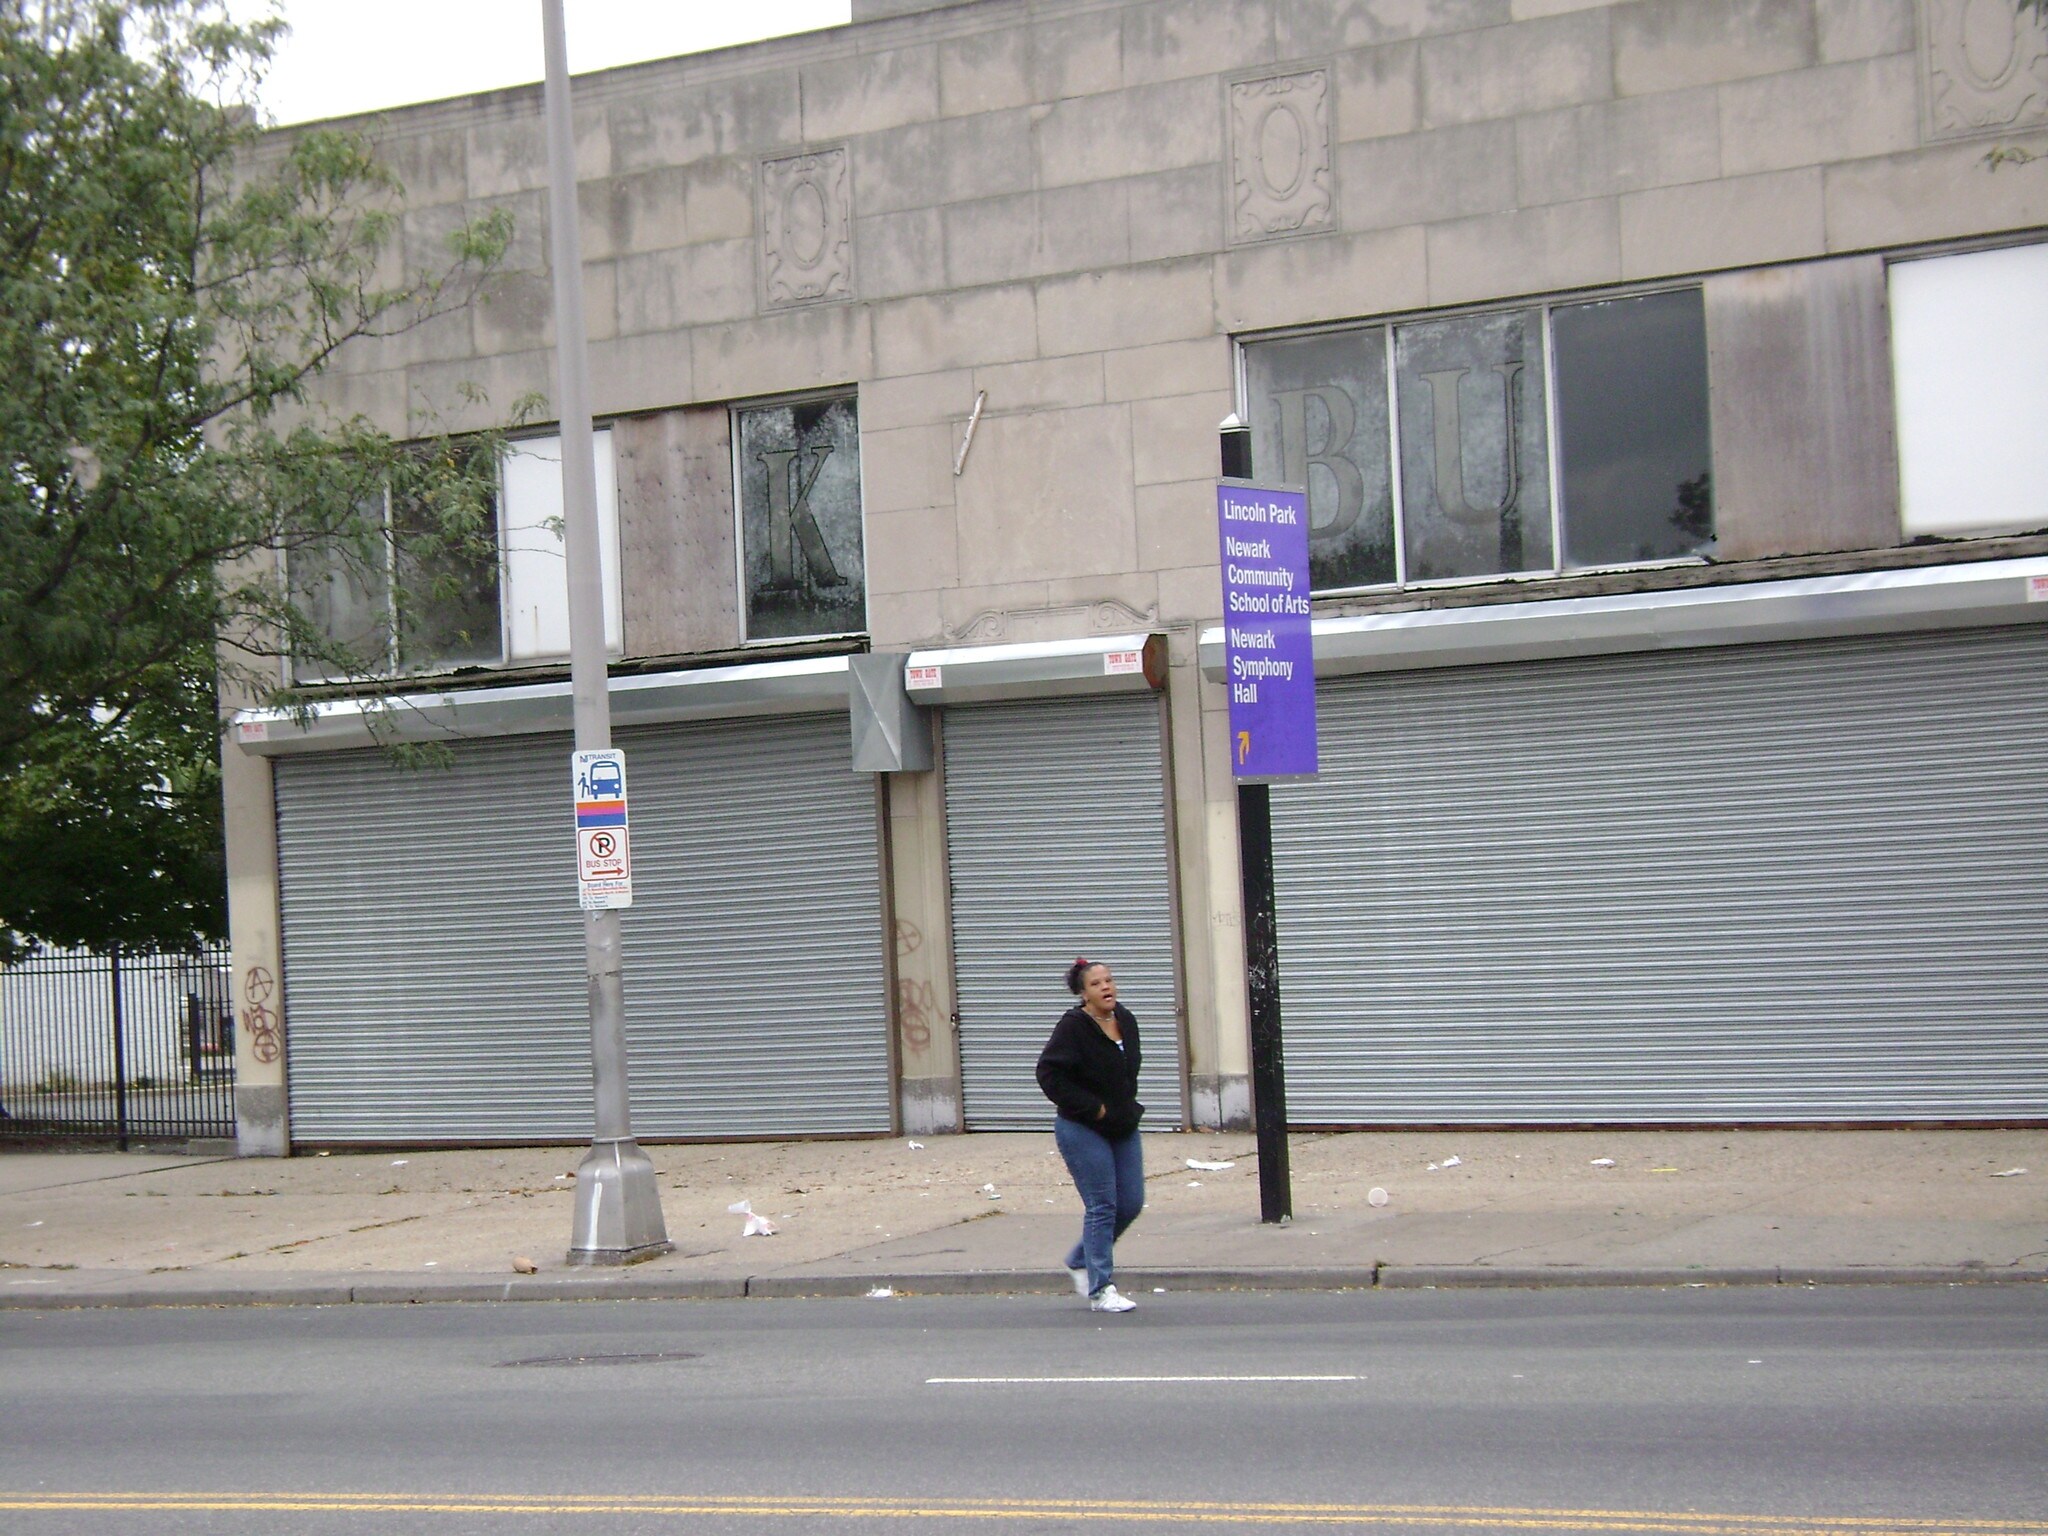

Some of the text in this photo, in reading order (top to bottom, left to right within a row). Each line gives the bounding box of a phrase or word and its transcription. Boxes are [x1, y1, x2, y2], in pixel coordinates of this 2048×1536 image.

[757, 446, 848, 592] K
[1224, 499, 1297, 525] Lincoln Park
[1226, 536, 1271, 559] Newark
[1228, 563, 1294, 591] Community
[1229, 591, 1310, 614] School of Arts
[1231, 628, 1276, 649] Newark
[1233, 655, 1293, 681] Symphony
[1234, 683, 1257, 704] Hall
[586, 858, 622, 868] BUS STOP
